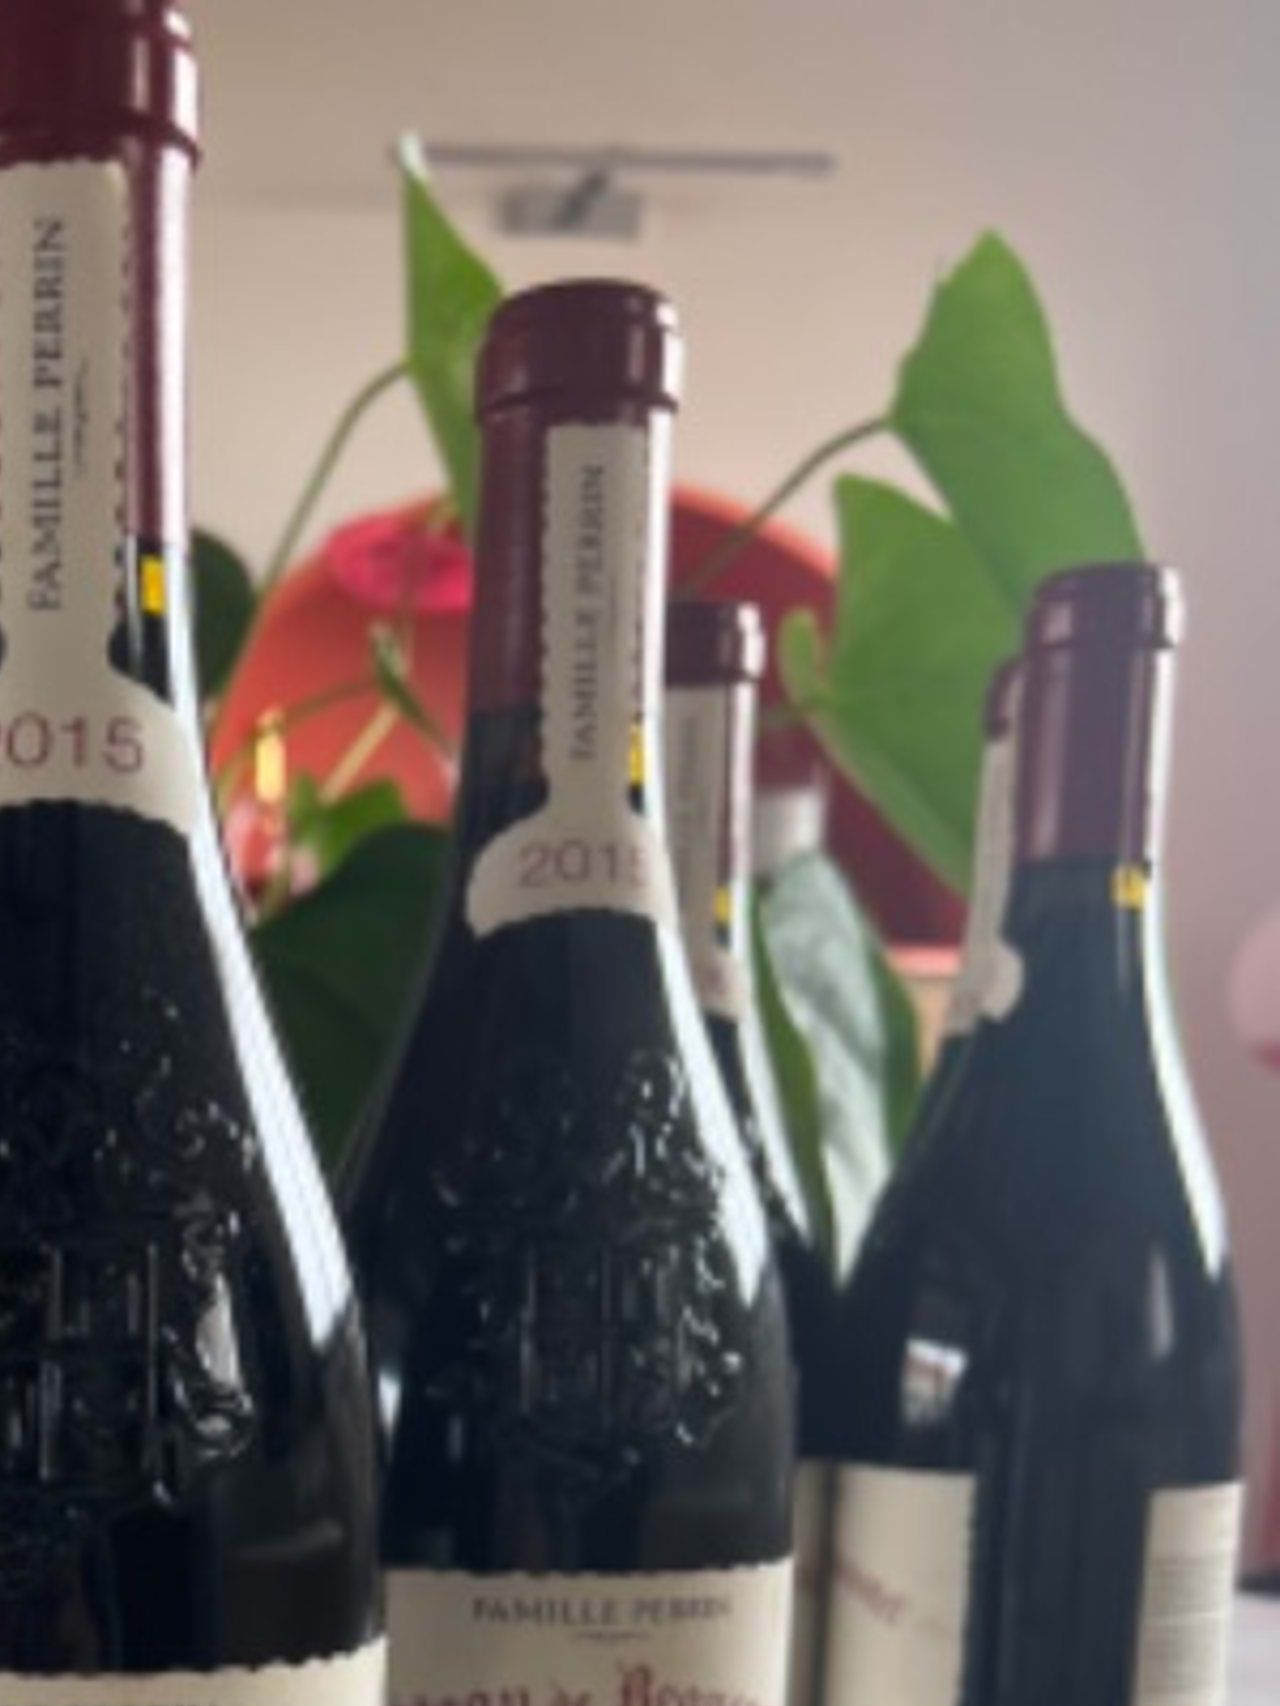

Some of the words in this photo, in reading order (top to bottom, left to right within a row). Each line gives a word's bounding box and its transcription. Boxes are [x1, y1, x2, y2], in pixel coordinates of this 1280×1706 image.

[32, 216, 67, 392] PERRIN
[29, 408, 64, 611] FAMILLE
[473, 1595, 616, 1627] FAMILLE
